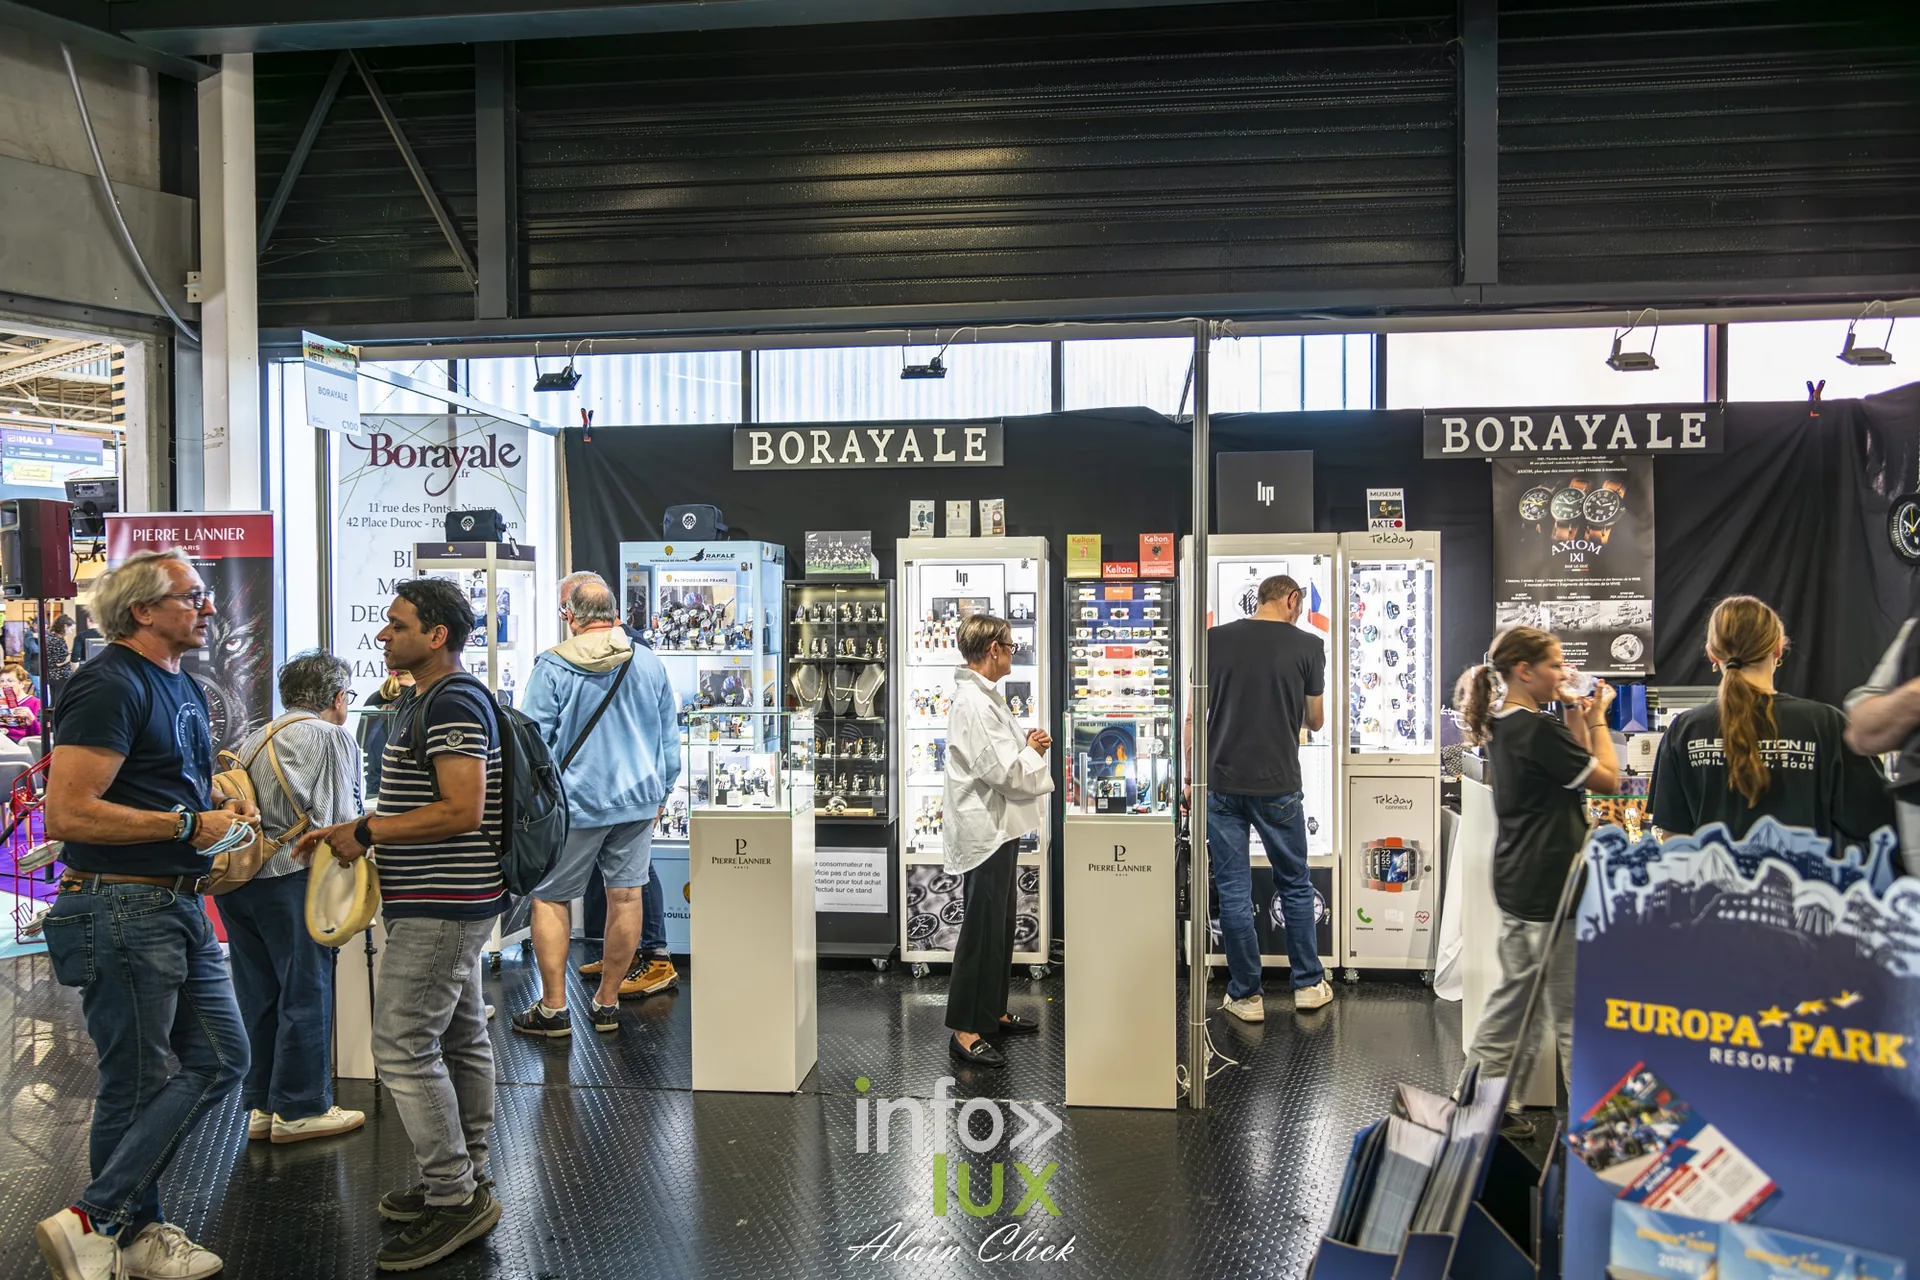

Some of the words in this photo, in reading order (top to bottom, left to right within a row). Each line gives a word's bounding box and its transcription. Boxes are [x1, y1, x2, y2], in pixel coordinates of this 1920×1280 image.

[308, 351, 325, 364] METZ
[318, 386, 348, 402] BORAYALE
[342, 420, 359, 432] C100
[1442, 412, 1707, 453] BORAYALE
[19, 436, 44, 445] HALL
[749, 428, 987, 465] BORAYALE
[367, 433, 521, 497] Borayale
[459, 468, 470, 478] .fr
[368, 503, 380, 513] 11
[382, 505, 400, 513] rue
[402, 502, 420, 513] des
[423, 503, 452, 513] Ponts
[346, 517, 359, 527] 42
[361, 517, 388, 528] Place
[390, 517, 423, 528] Duroc
[133, 528, 180, 542] PIERRE
[185, 527, 245, 541] LANNIER
[1369, 532, 1414, 550] Tekday
[1552, 539, 1603, 556] AXIOM
[1691, 759, 1724, 767] APRIL
[1782, 761, 1815, 769] 2005
[1372, 793, 1413, 810] Tekday
[711, 856, 737, 865] PIERRE
[738, 856, 771, 865] LANNIER
[1088, 863, 1116, 872] PIERRE
[1117, 863, 1152, 873] LANNIER
[1604, 998, 1763, 1048] EUROPA
[1788, 1019, 1908, 1069] PARK
[1708, 1046, 1795, 1075] RESORT
